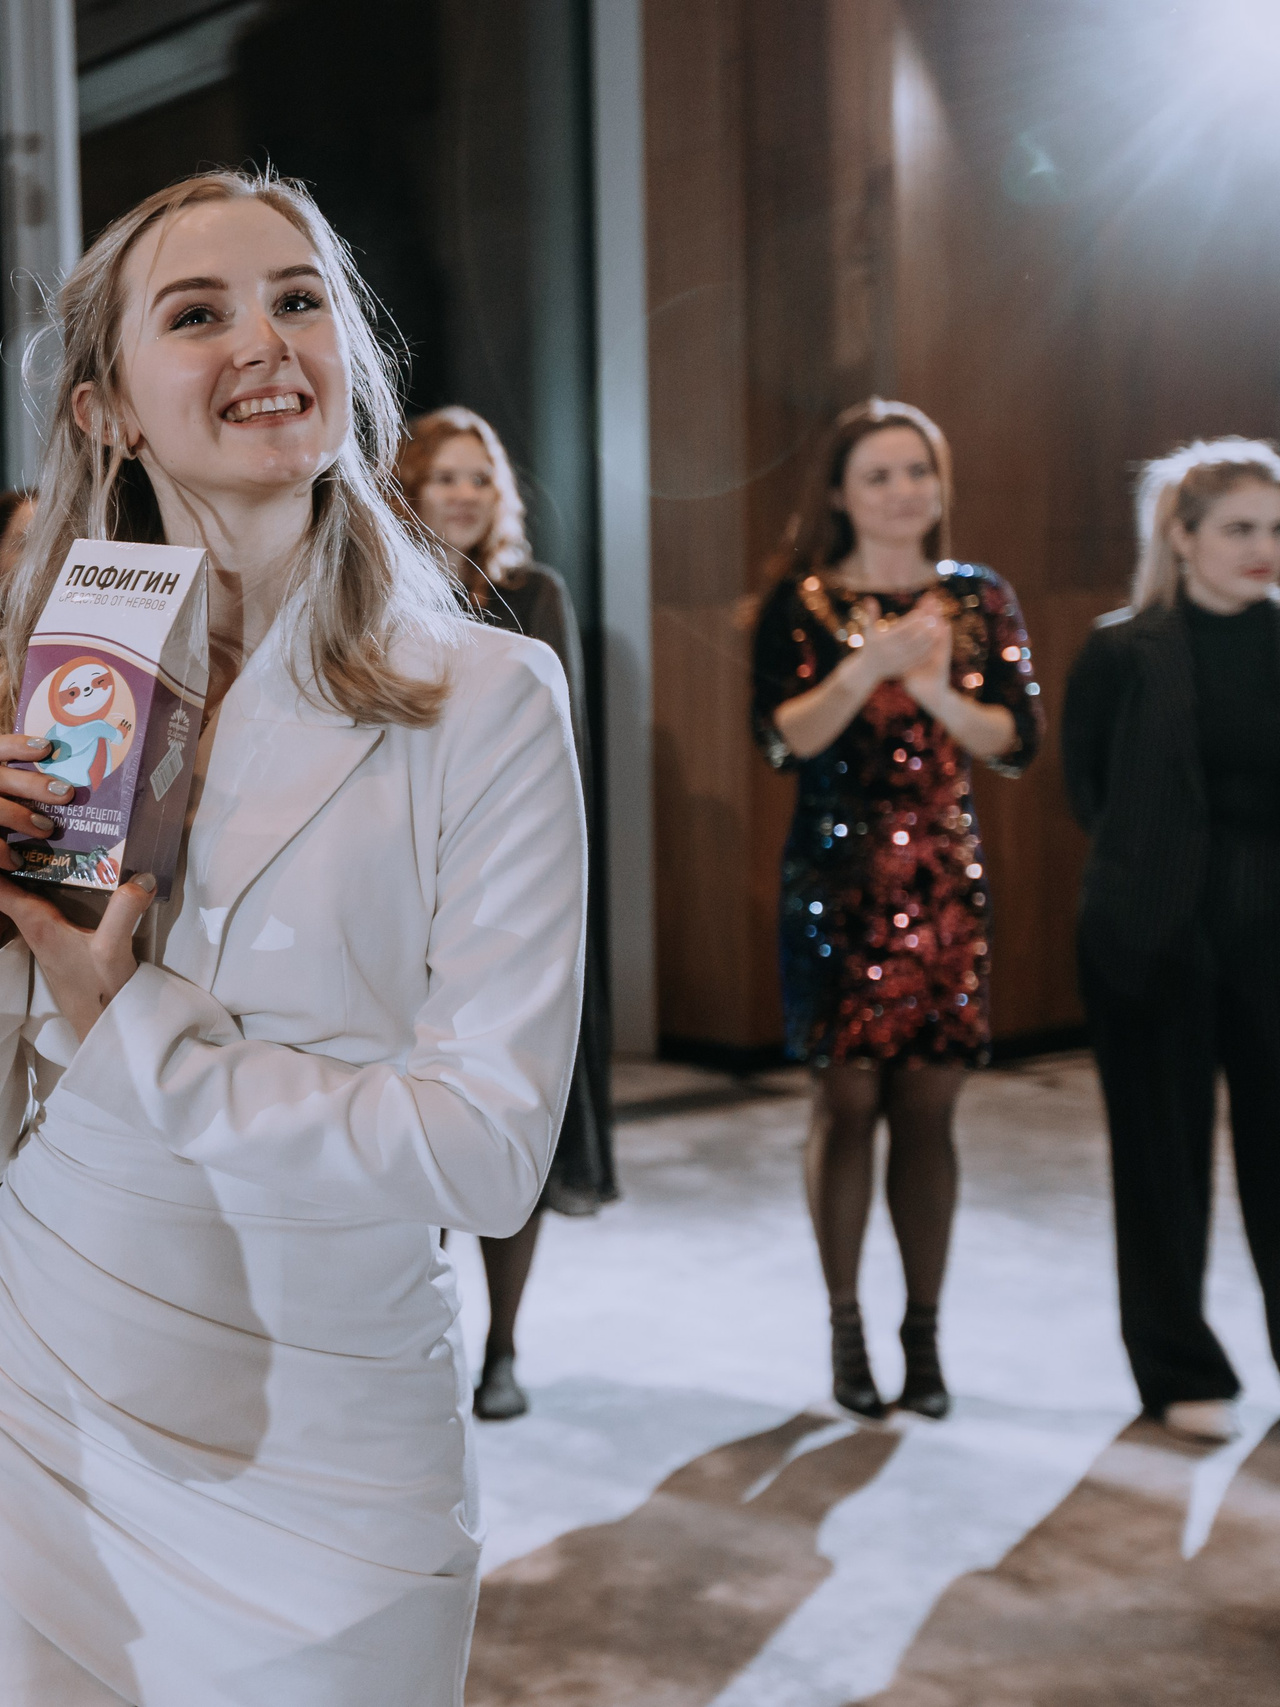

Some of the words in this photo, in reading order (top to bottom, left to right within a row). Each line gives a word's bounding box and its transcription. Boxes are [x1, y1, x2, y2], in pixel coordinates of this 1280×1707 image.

[65, 565, 180, 595] ПОФИГИН
[110, 595, 125, 606] ОТ
[125, 597, 167, 611] НЕРВОВ
[67, 804, 84, 817] БЕЗ
[86, 806, 122, 822] РЕЦЕПТА
[23, 849, 71, 867] ЧЁРНЫЙ
